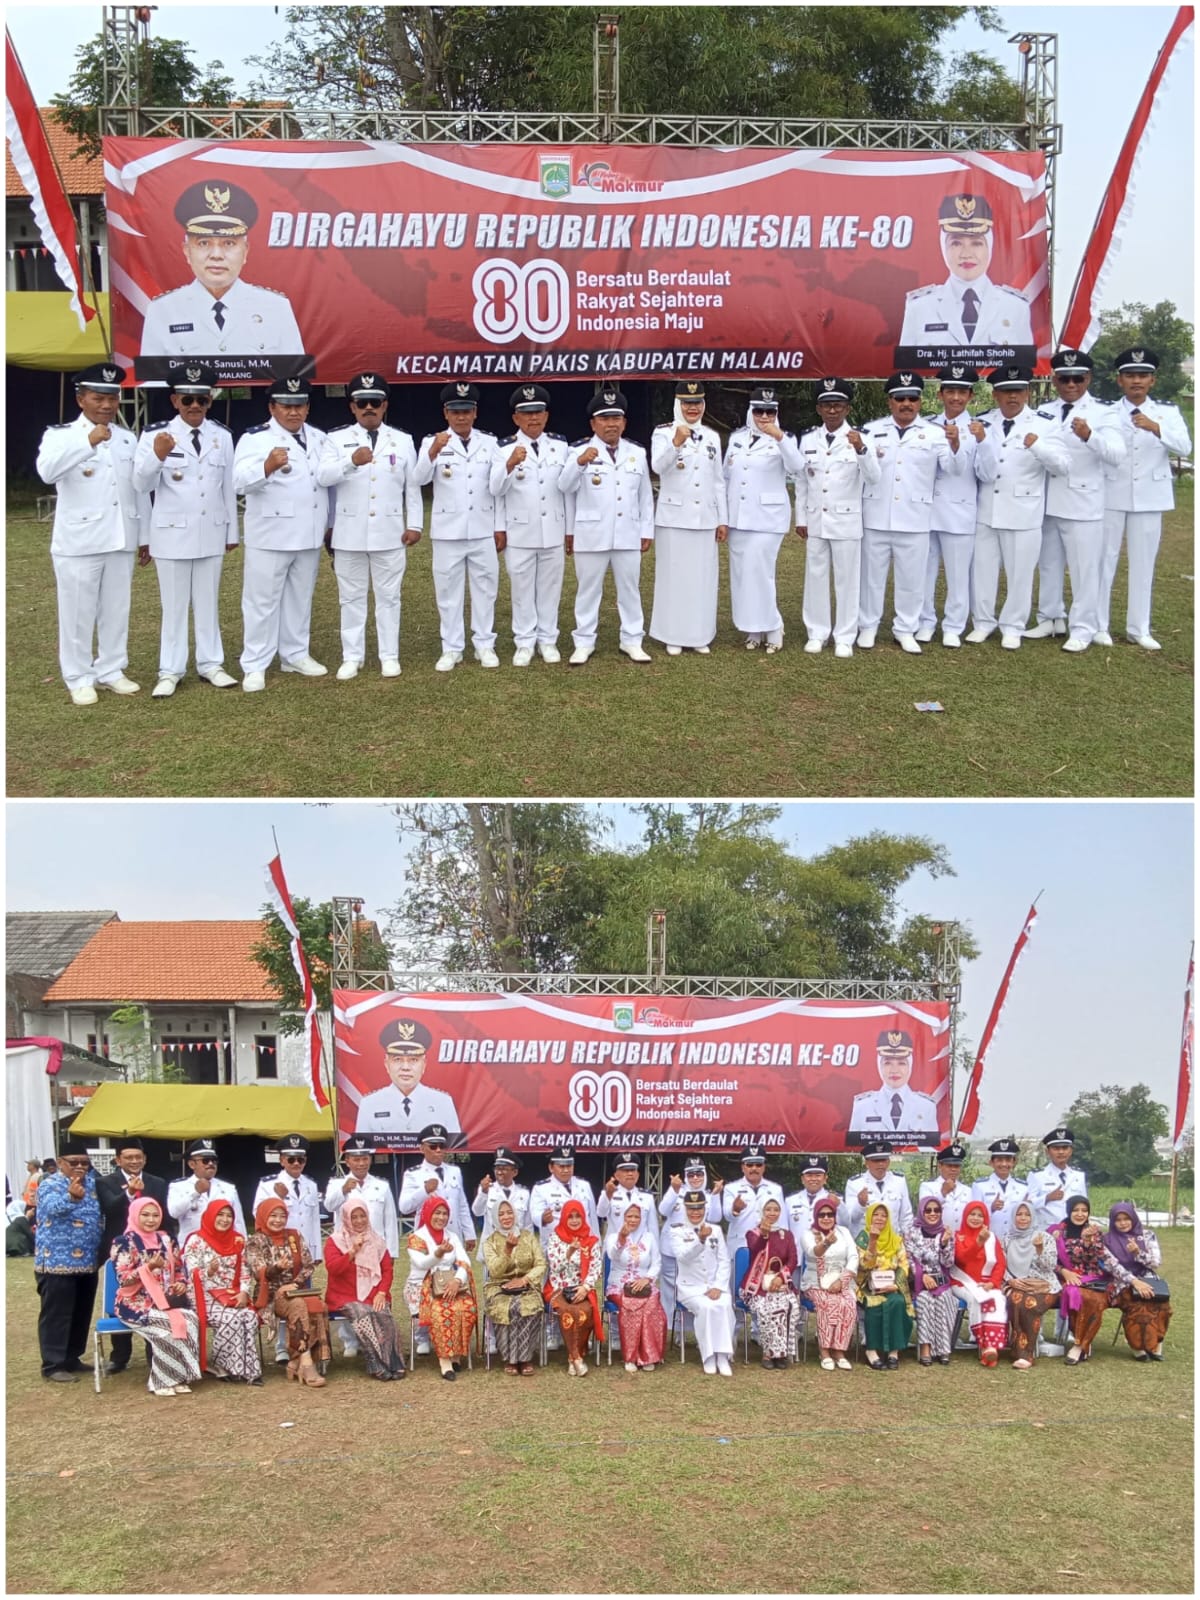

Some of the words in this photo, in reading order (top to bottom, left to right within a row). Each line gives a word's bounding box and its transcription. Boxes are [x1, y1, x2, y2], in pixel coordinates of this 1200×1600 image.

[601, 179, 665, 193] Makmur
[267, 211, 468, 249] DIRGAHAYU
[474, 212, 637, 249] REPUBLIK
[640, 213, 812, 250] INDONESIA
[819, 215, 914, 250] KE-80
[576, 270, 644, 288] Bersatu
[647, 269, 732, 287] Berdaulat
[471, 257, 571, 344] 80
[576, 292, 635, 313] Rakyat
[639, 291, 724, 311] Sejahtera
[576, 314, 660, 331] Indonesia
[664, 313, 704, 333] Maju
[396, 354, 524, 374] KECAMATAN
[529, 353, 590, 372] PAKIS
[595, 352, 718, 372] KABUPATEN
[720, 351, 804, 370] MALANG
[916, 349, 935, 358] Dra.
[937, 349, 949, 360] Hj.
[951, 349, 985, 358] Lathifah
[986, 348, 1016, 357] Shohib
[214, 359, 246, 370] Sanusi,
[248, 359, 272, 369] M.M.
[653, 1019, 695, 1028] Makmur
[437, 1038, 567, 1064] DIRGAHAYU
[570, 1040, 676, 1065] REPUBLIK
[678, 1041, 793, 1066] INDONESIA
[797, 1043, 860, 1067] KE-80
[635, 1079, 681, 1091] Bersatu
[683, 1079, 738, 1091] Berdaulat
[568, 1069, 632, 1128] 80
[635, 1093, 675, 1107] Rakyat
[677, 1092, 733, 1107] Sejahtera
[635, 1107, 691, 1120] Indonesia
[693, 1107, 720, 1121] Maju
[518, 1133, 601, 1147] KECAMATAN
[604, 1133, 644, 1147] PAKIS
[647, 1133, 728, 1147] KABUPATEN
[729, 1133, 786, 1147] MALANG
